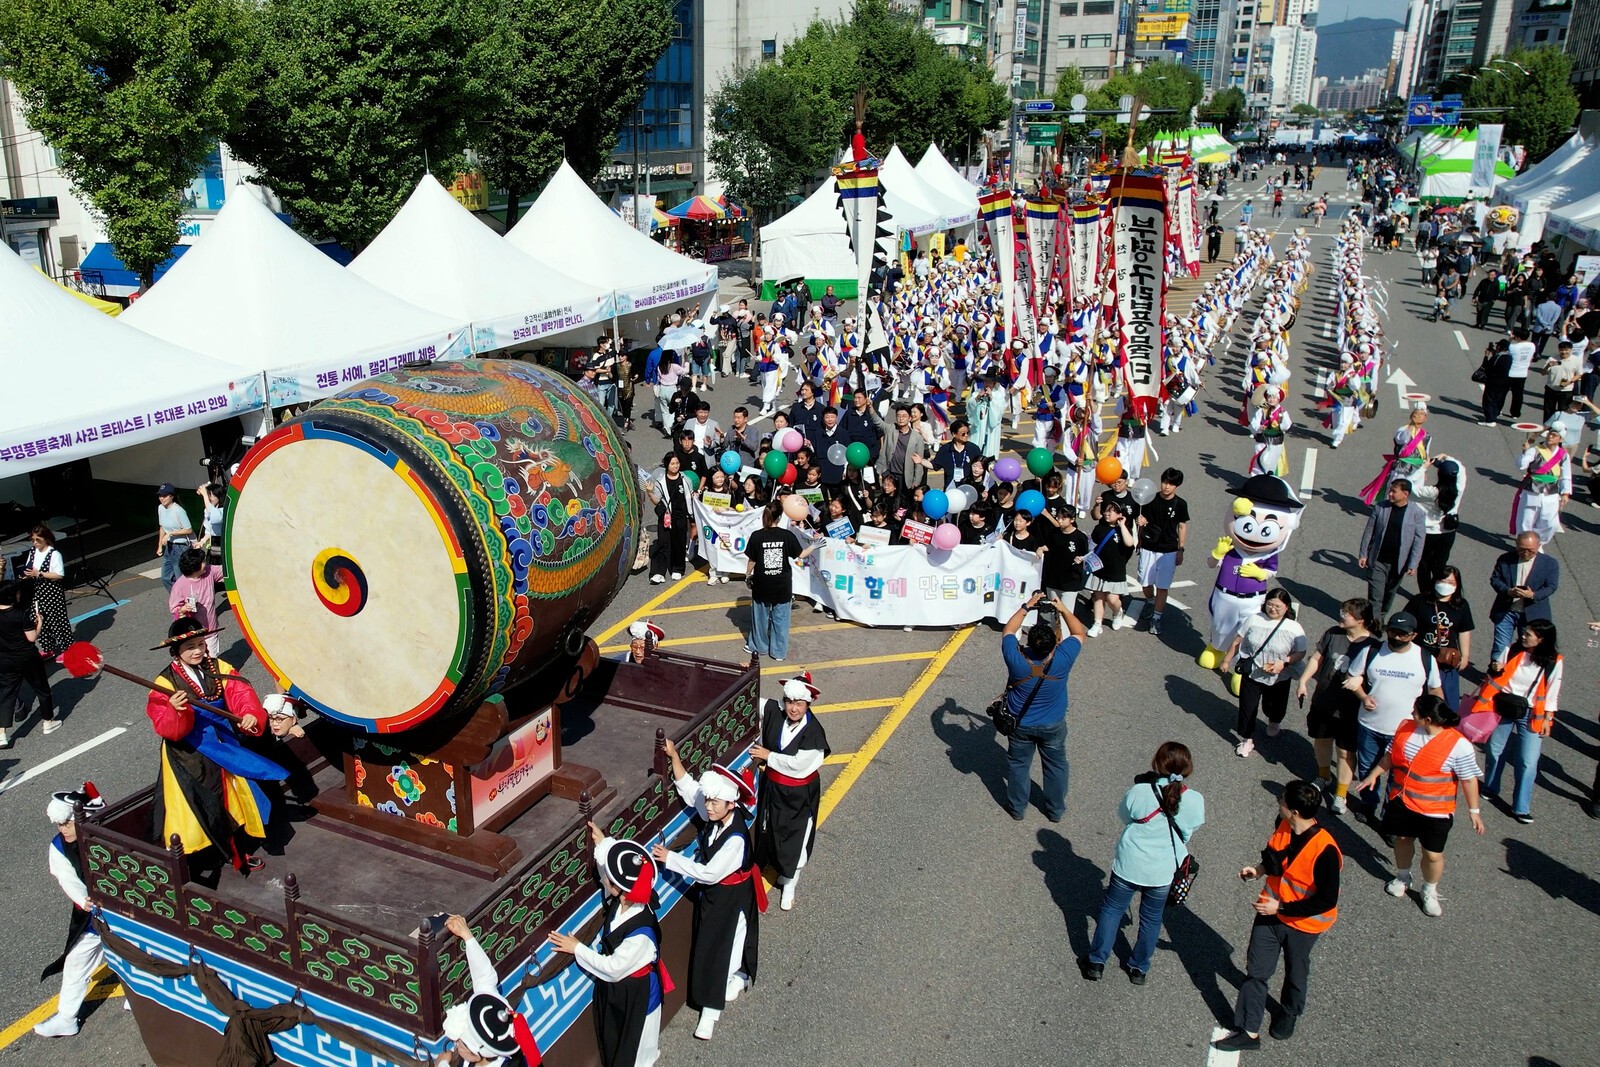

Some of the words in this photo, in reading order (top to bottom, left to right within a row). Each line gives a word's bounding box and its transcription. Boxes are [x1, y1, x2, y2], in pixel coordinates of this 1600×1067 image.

[513, 327, 531, 340] 한국의
[316, 370, 339, 390] 전통
[341, 364, 366, 382] 서예,
[418, 345, 436, 361] 체험
[0, 431, 73, 462] 부평풍물축제
[75, 426, 99, 443] 사진
[100, 415, 145, 439] 콘테스트
[154, 405, 186, 424] 휴대폰
[187, 400, 207, 417] 사진
[208, 394, 228, 411] 인화
[762, 541, 785, 553] STAFF
[864, 576, 907, 600] 함께
[1388, 669, 1415, 677] ANGELES
